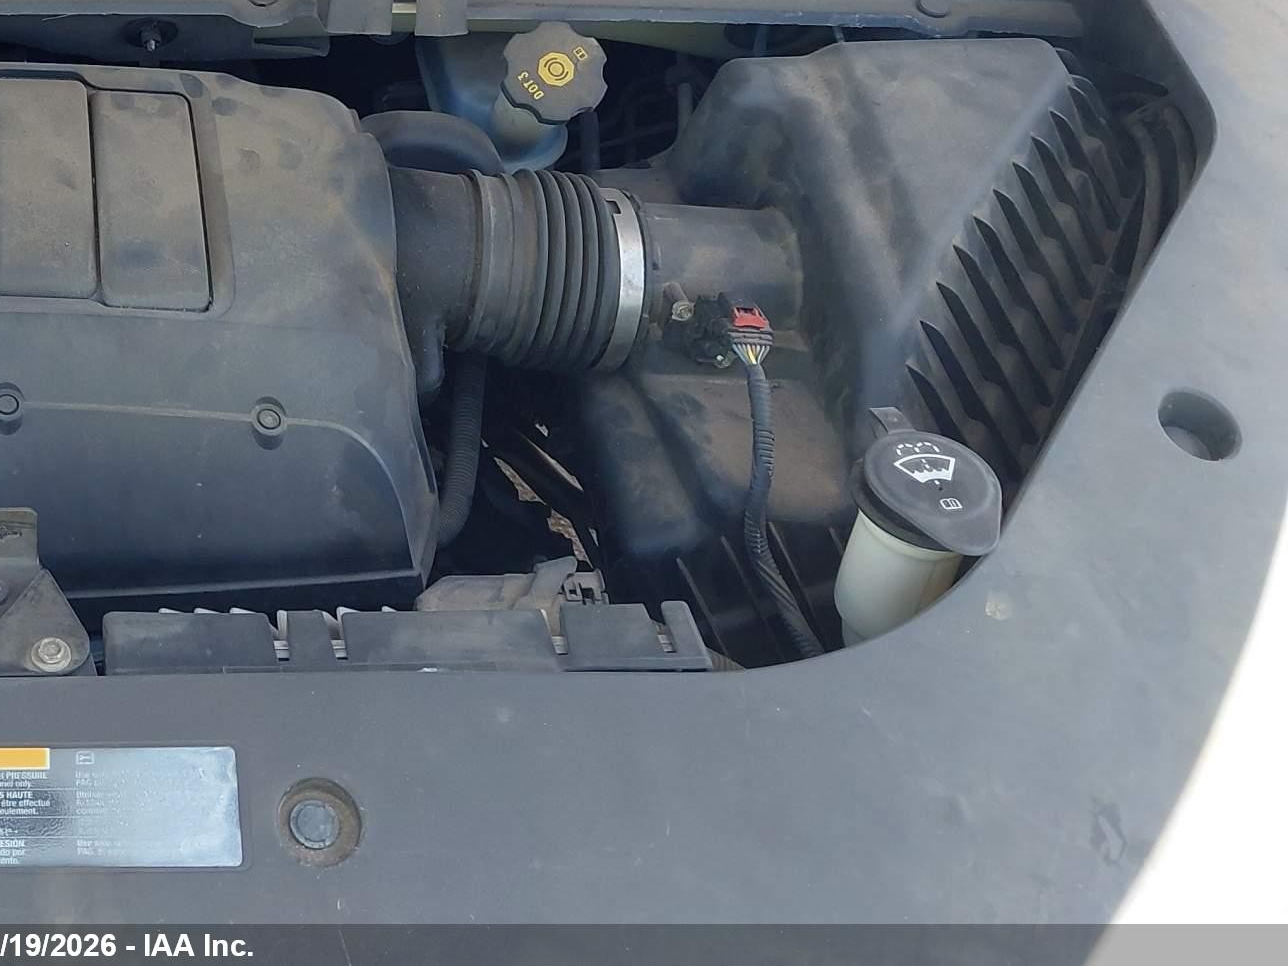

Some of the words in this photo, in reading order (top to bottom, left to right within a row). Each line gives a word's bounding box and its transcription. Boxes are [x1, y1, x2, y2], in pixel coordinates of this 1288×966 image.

[517, 71, 529, 82] 3
[523, 80, 544, 100] DOT
[6, 771, 48, 780] PRESSURE
[6, 791, 33, 800] HAUTE
[1, 799, 17, 808] être
[18, 799, 51, 809] effectué
